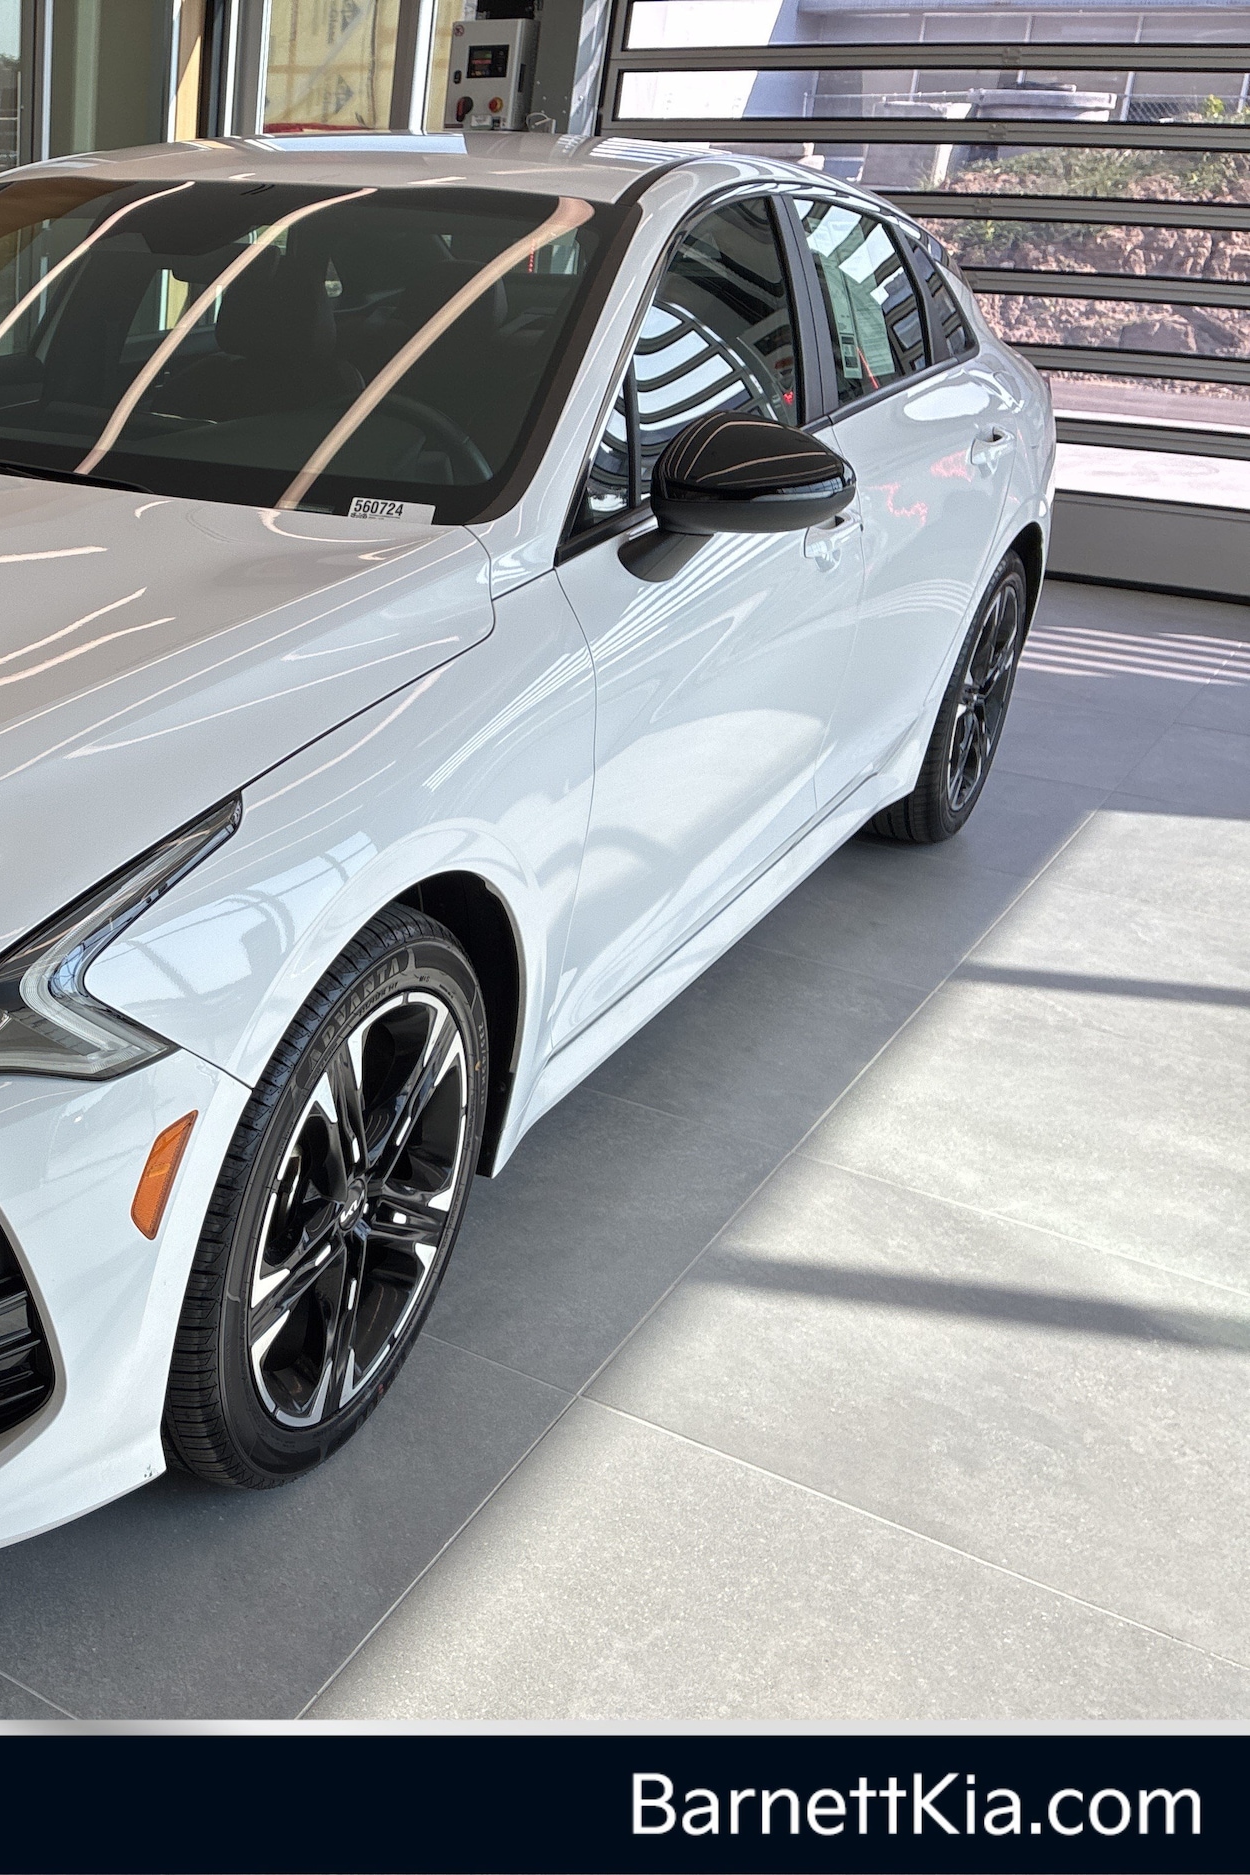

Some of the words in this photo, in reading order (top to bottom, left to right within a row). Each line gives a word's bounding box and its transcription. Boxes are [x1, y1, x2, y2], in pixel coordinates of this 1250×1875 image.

[353, 499, 404, 516] 560724
[307, 957, 402, 1071] ADVANTA
[340, 1189, 365, 1223] KIA
